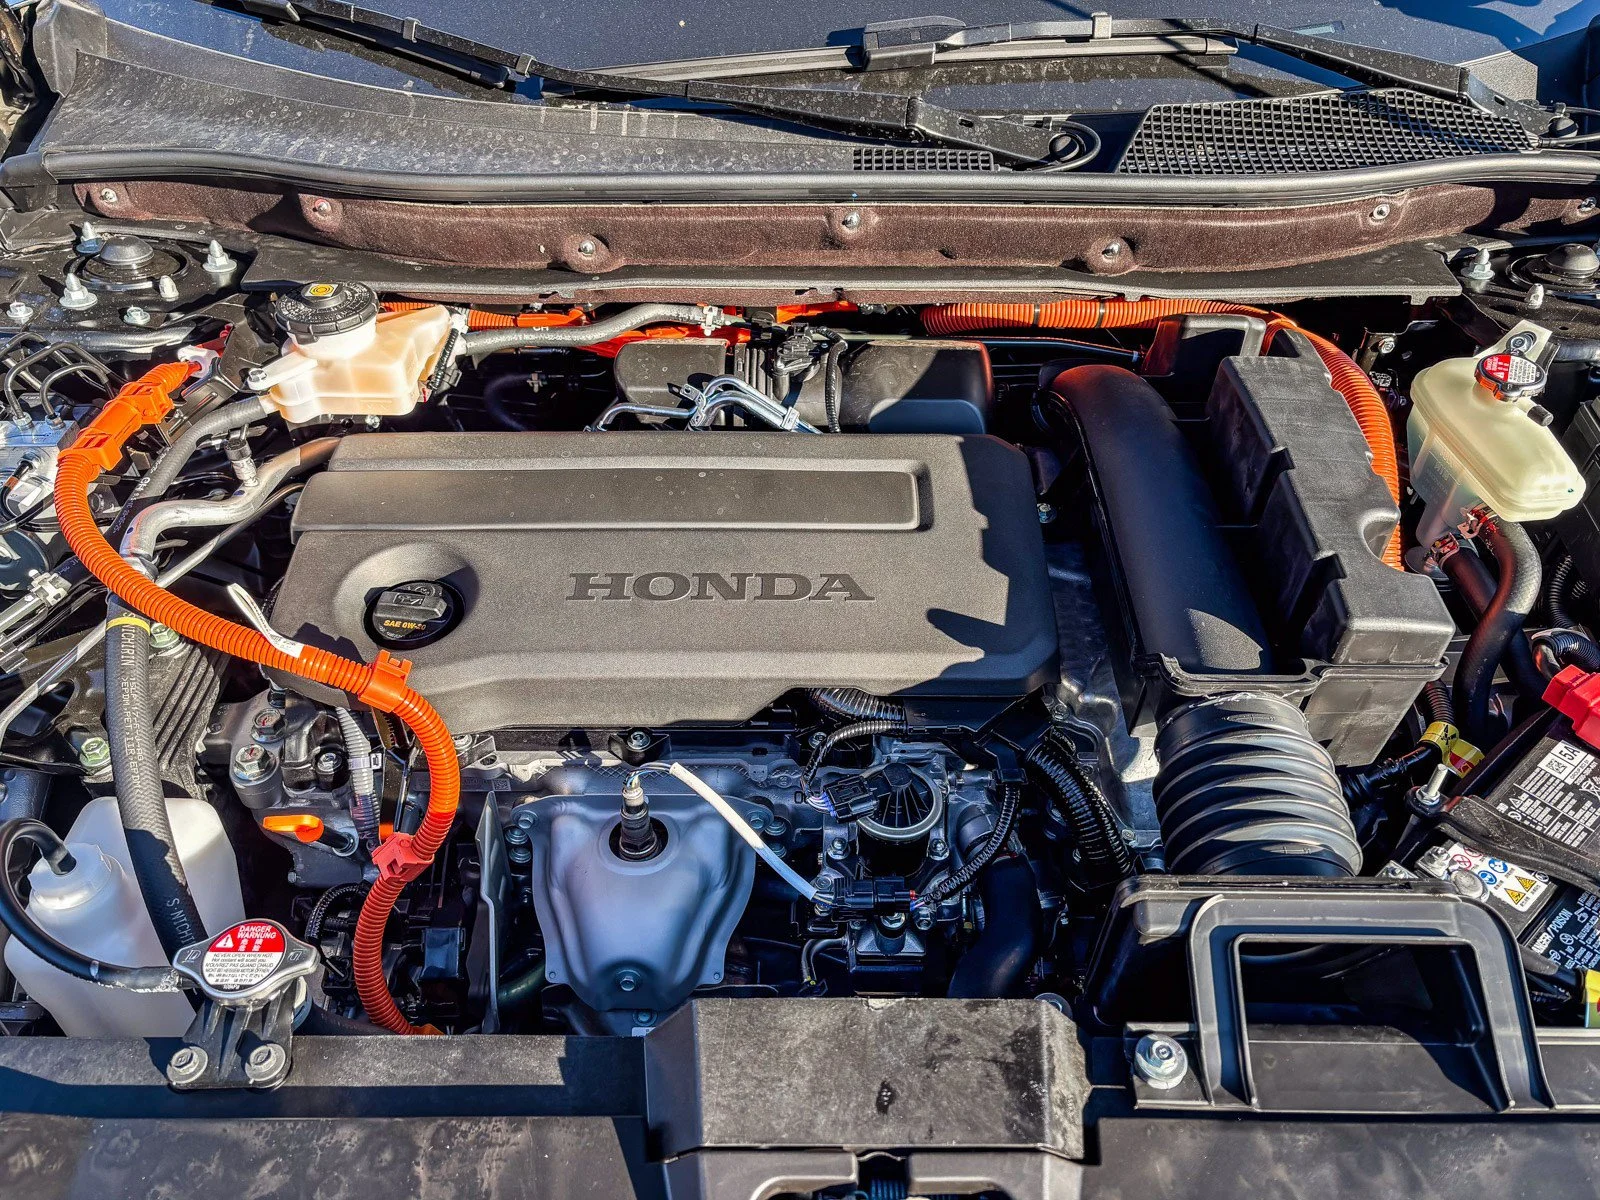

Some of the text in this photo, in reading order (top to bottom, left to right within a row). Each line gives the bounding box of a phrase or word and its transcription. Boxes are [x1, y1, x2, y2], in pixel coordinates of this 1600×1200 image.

[565, 571, 876, 602] HONDA
[384, 620, 426, 630] SAE 0W-20
[1559, 745, 1581, 761] 5A
[167, 898, 196, 945] S·NICHI
[237, 931, 276, 939] WARNUNG
